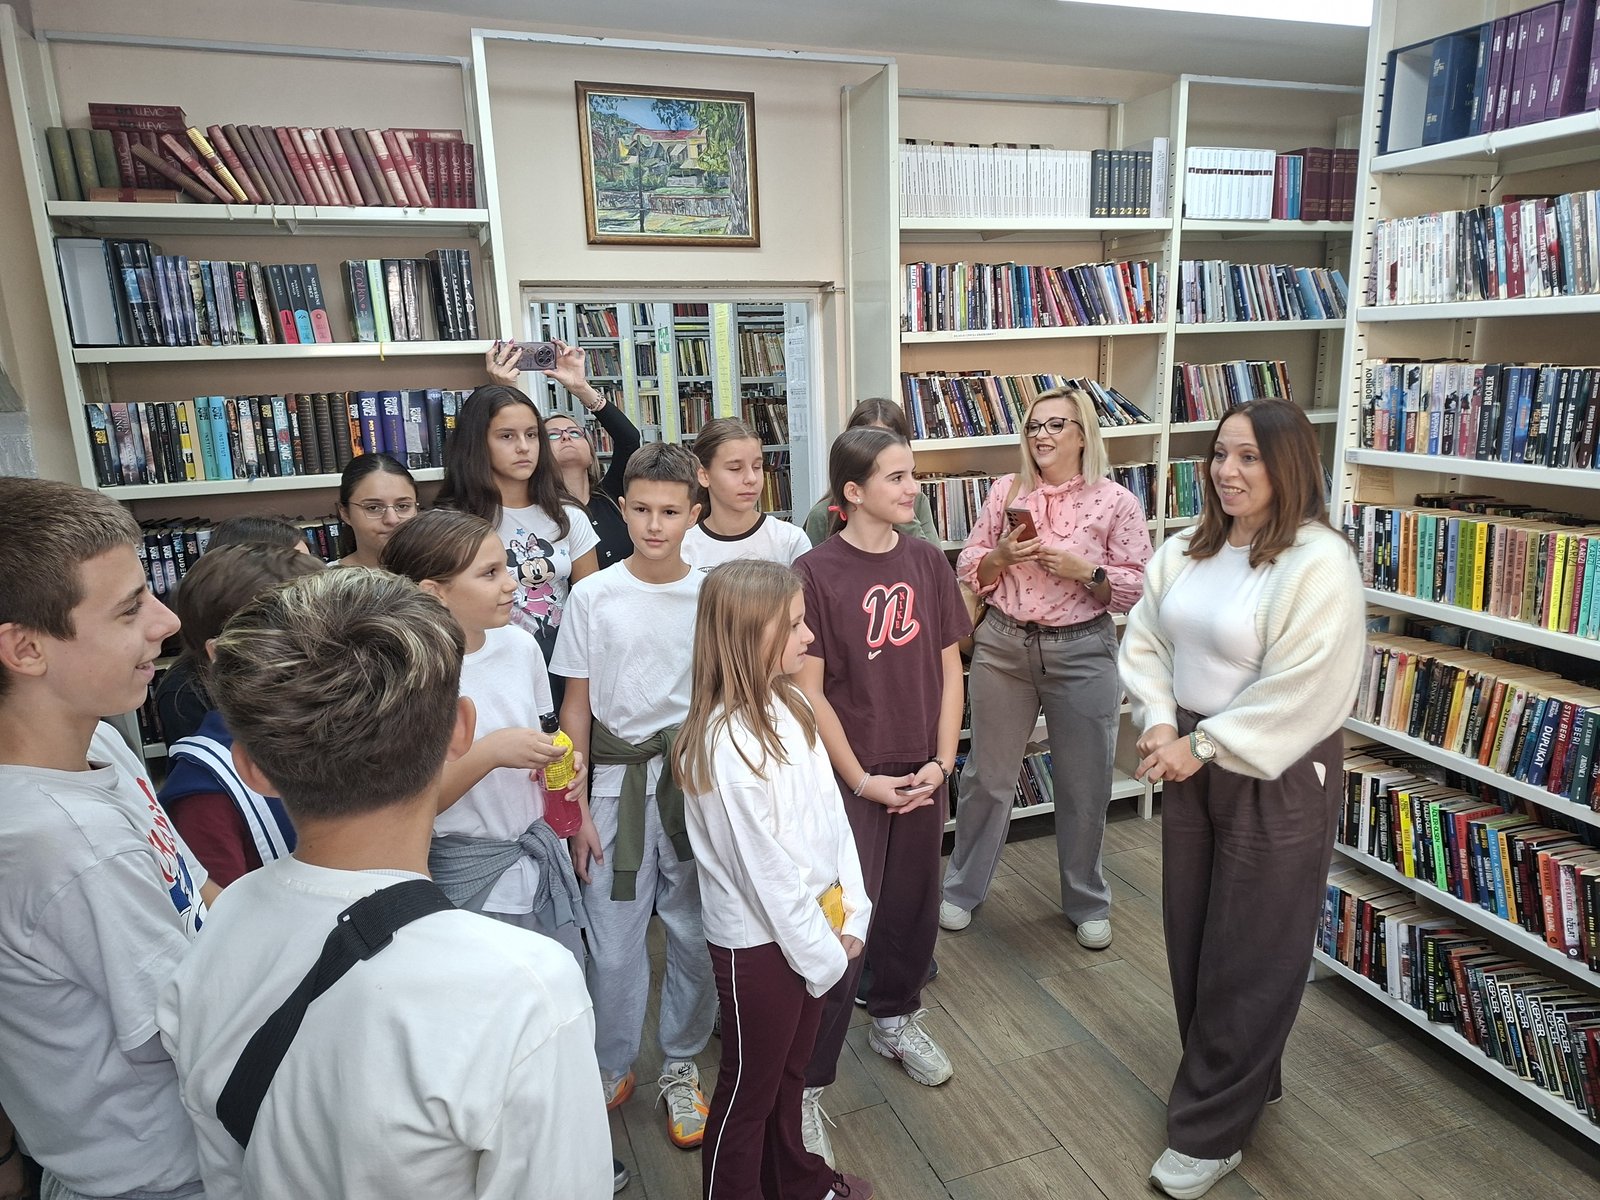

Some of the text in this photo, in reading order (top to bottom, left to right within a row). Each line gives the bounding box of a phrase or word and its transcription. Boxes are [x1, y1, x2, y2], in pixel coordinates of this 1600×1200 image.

[280, 444, 290, 460] KING
[1555, 538, 1565, 563] KARIZI
[1568, 539, 1579, 567] KARIZI
[1578, 542, 1587, 564] KARIZI
[896, 592, 905, 628] NIKE
[1558, 704, 1572, 742] STIV BERI
[1572, 707, 1586, 745] STIV BERI
[1534, 725, 1554, 768] DUPLIKAT
[1486, 979, 1500, 1013] KEPLER
[1500, 988, 1514, 1024] KEPLER
[1514, 993, 1529, 1029] KEPLER
[1529, 1000, 1545, 1037] KEPLER
[1544, 1008, 1559, 1045] KEPLER
[1555, 1016, 1571, 1053] KEPLER
